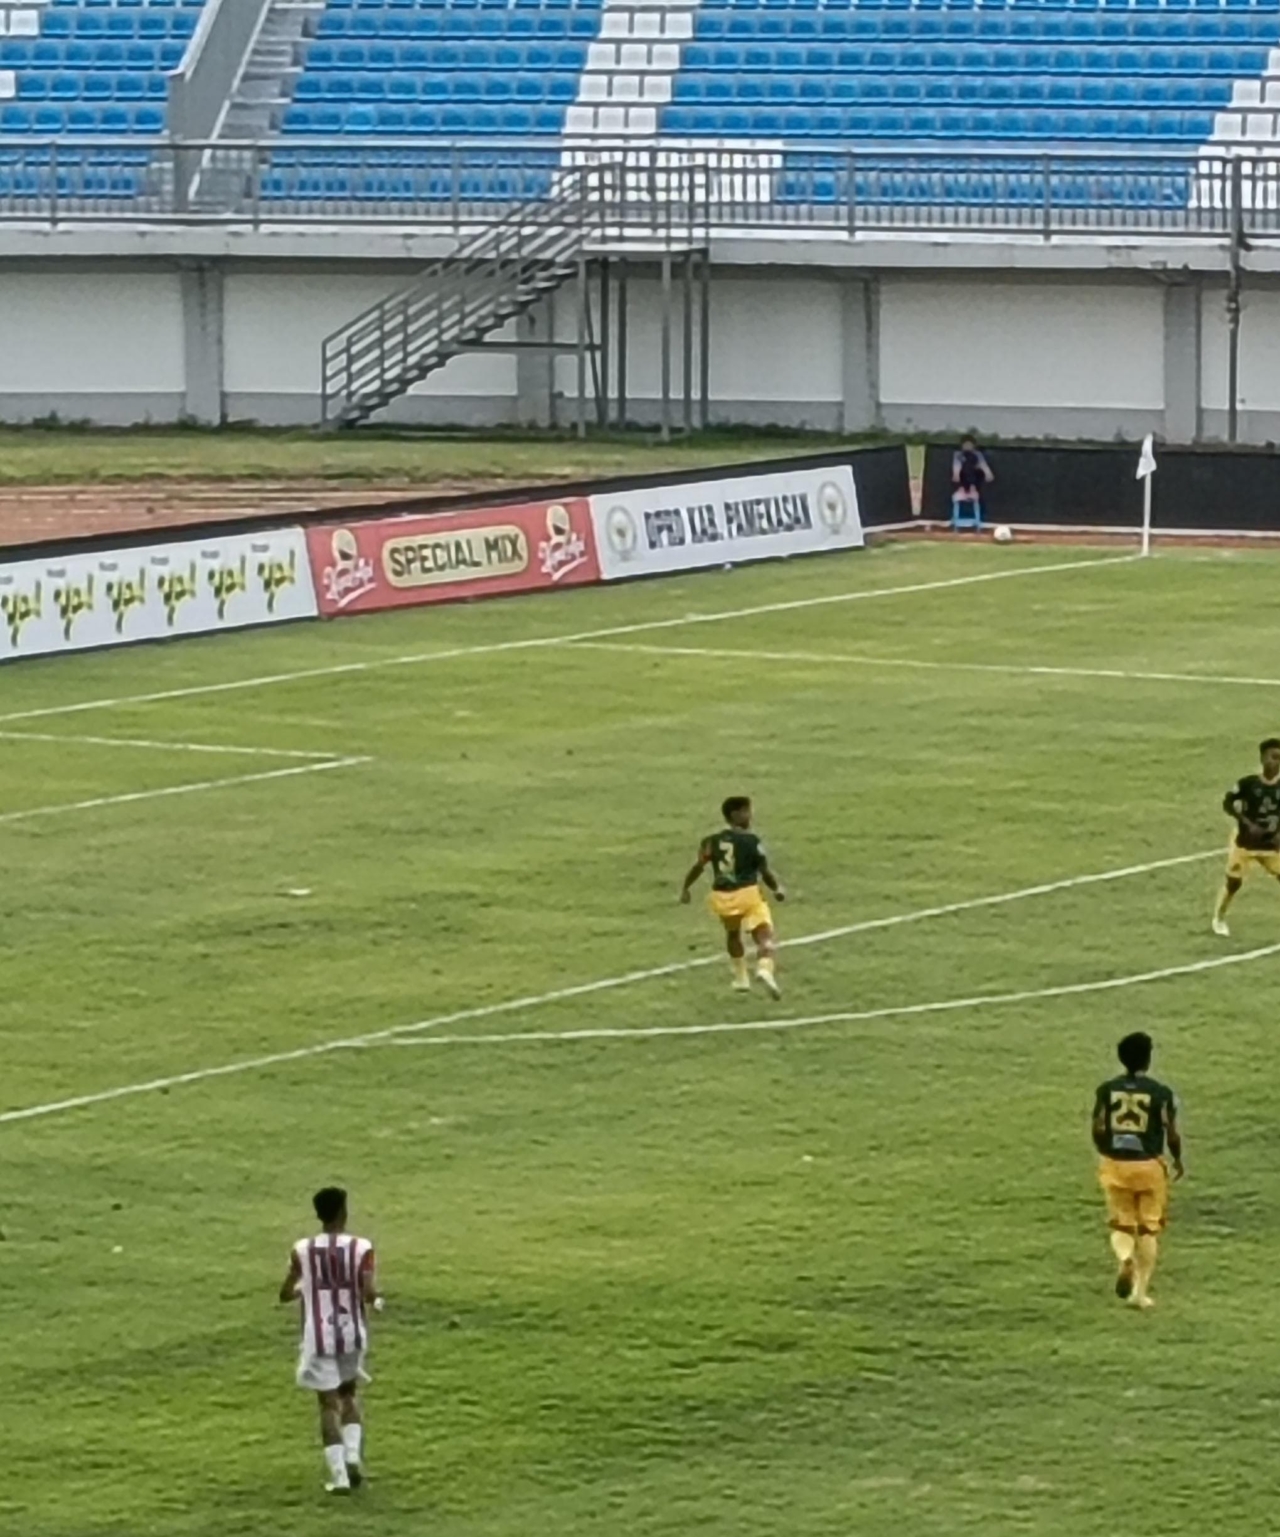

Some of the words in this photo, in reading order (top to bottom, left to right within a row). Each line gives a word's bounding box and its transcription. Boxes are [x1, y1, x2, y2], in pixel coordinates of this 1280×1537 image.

[724, 493, 813, 539] PAMEKASAN
[388, 538, 482, 578] SPECIAL
[484, 533, 523, 565] MIX
[1110, 1090, 1151, 1133] 25
